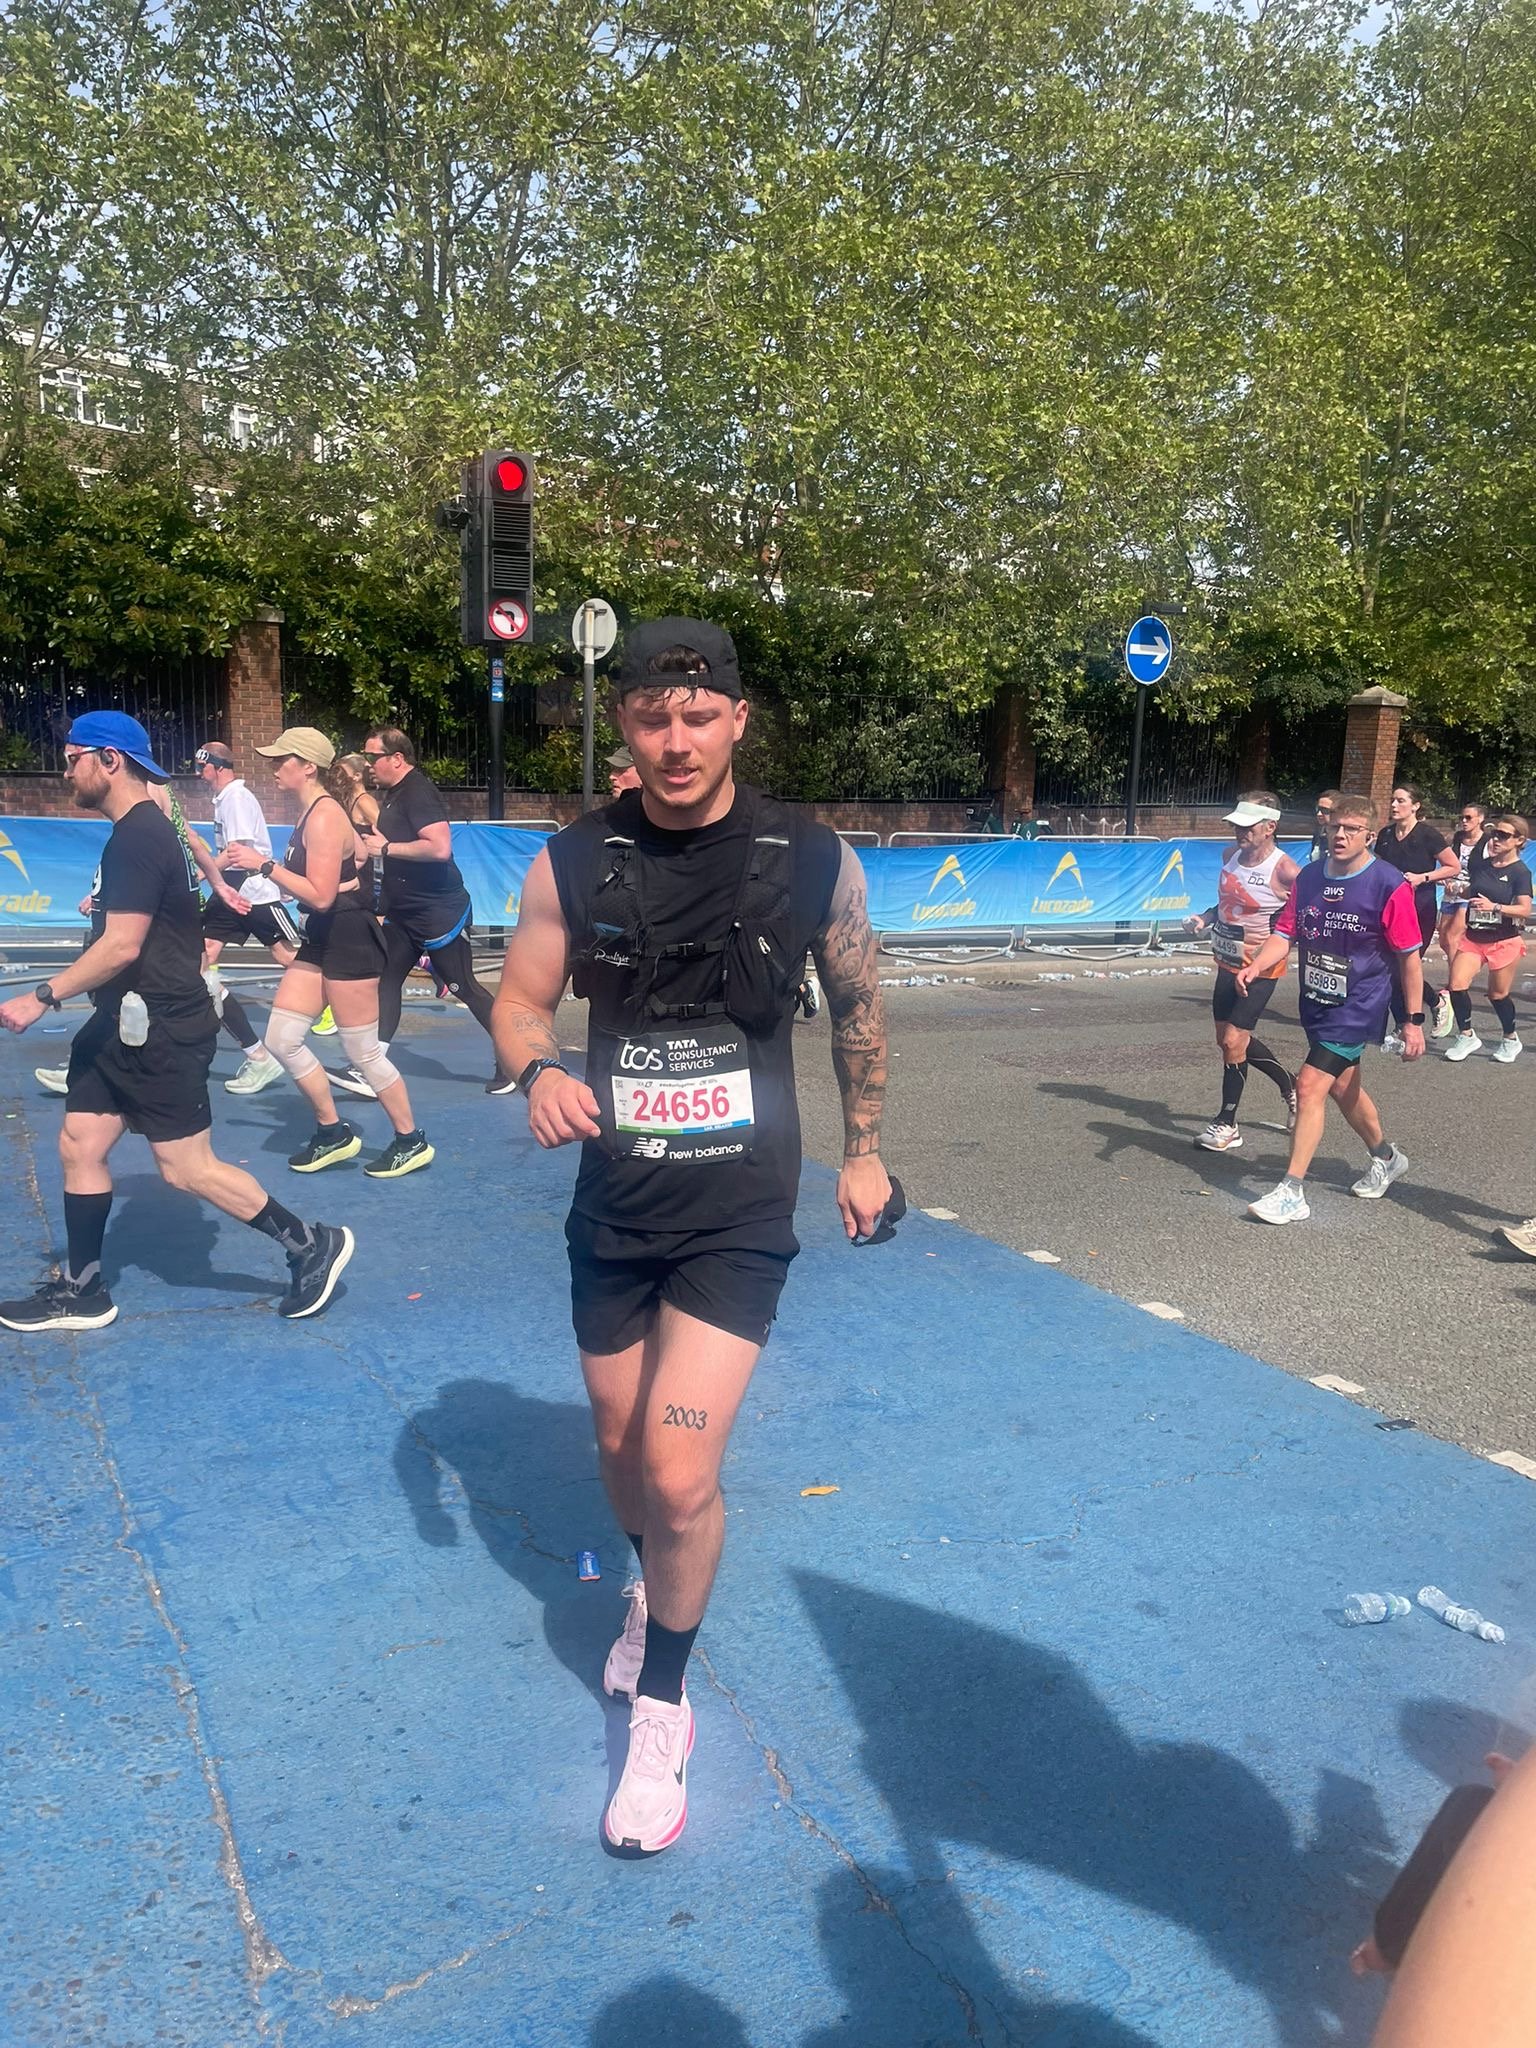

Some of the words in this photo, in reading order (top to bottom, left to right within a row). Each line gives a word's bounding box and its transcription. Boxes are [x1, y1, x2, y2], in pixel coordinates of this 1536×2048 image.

[1323, 886, 1345, 896] aws
[912, 898, 976, 921] Lucozade
[1031, 896, 1094, 913] Lucozade
[1325, 911, 1359, 923] CANCER
[1324, 920, 1367, 932] RESEARCH
[667, 1038, 698, 1050] TATA
[668, 1043, 738, 1062] CONSULTANCY
[669, 1058, 715, 1072] SERVICES
[632, 1085, 730, 1122] 24656
[669, 1150, 693, 1160] new
[695, 1143, 744, 1158] balance
[662, 1404, 708, 1431] 2003
